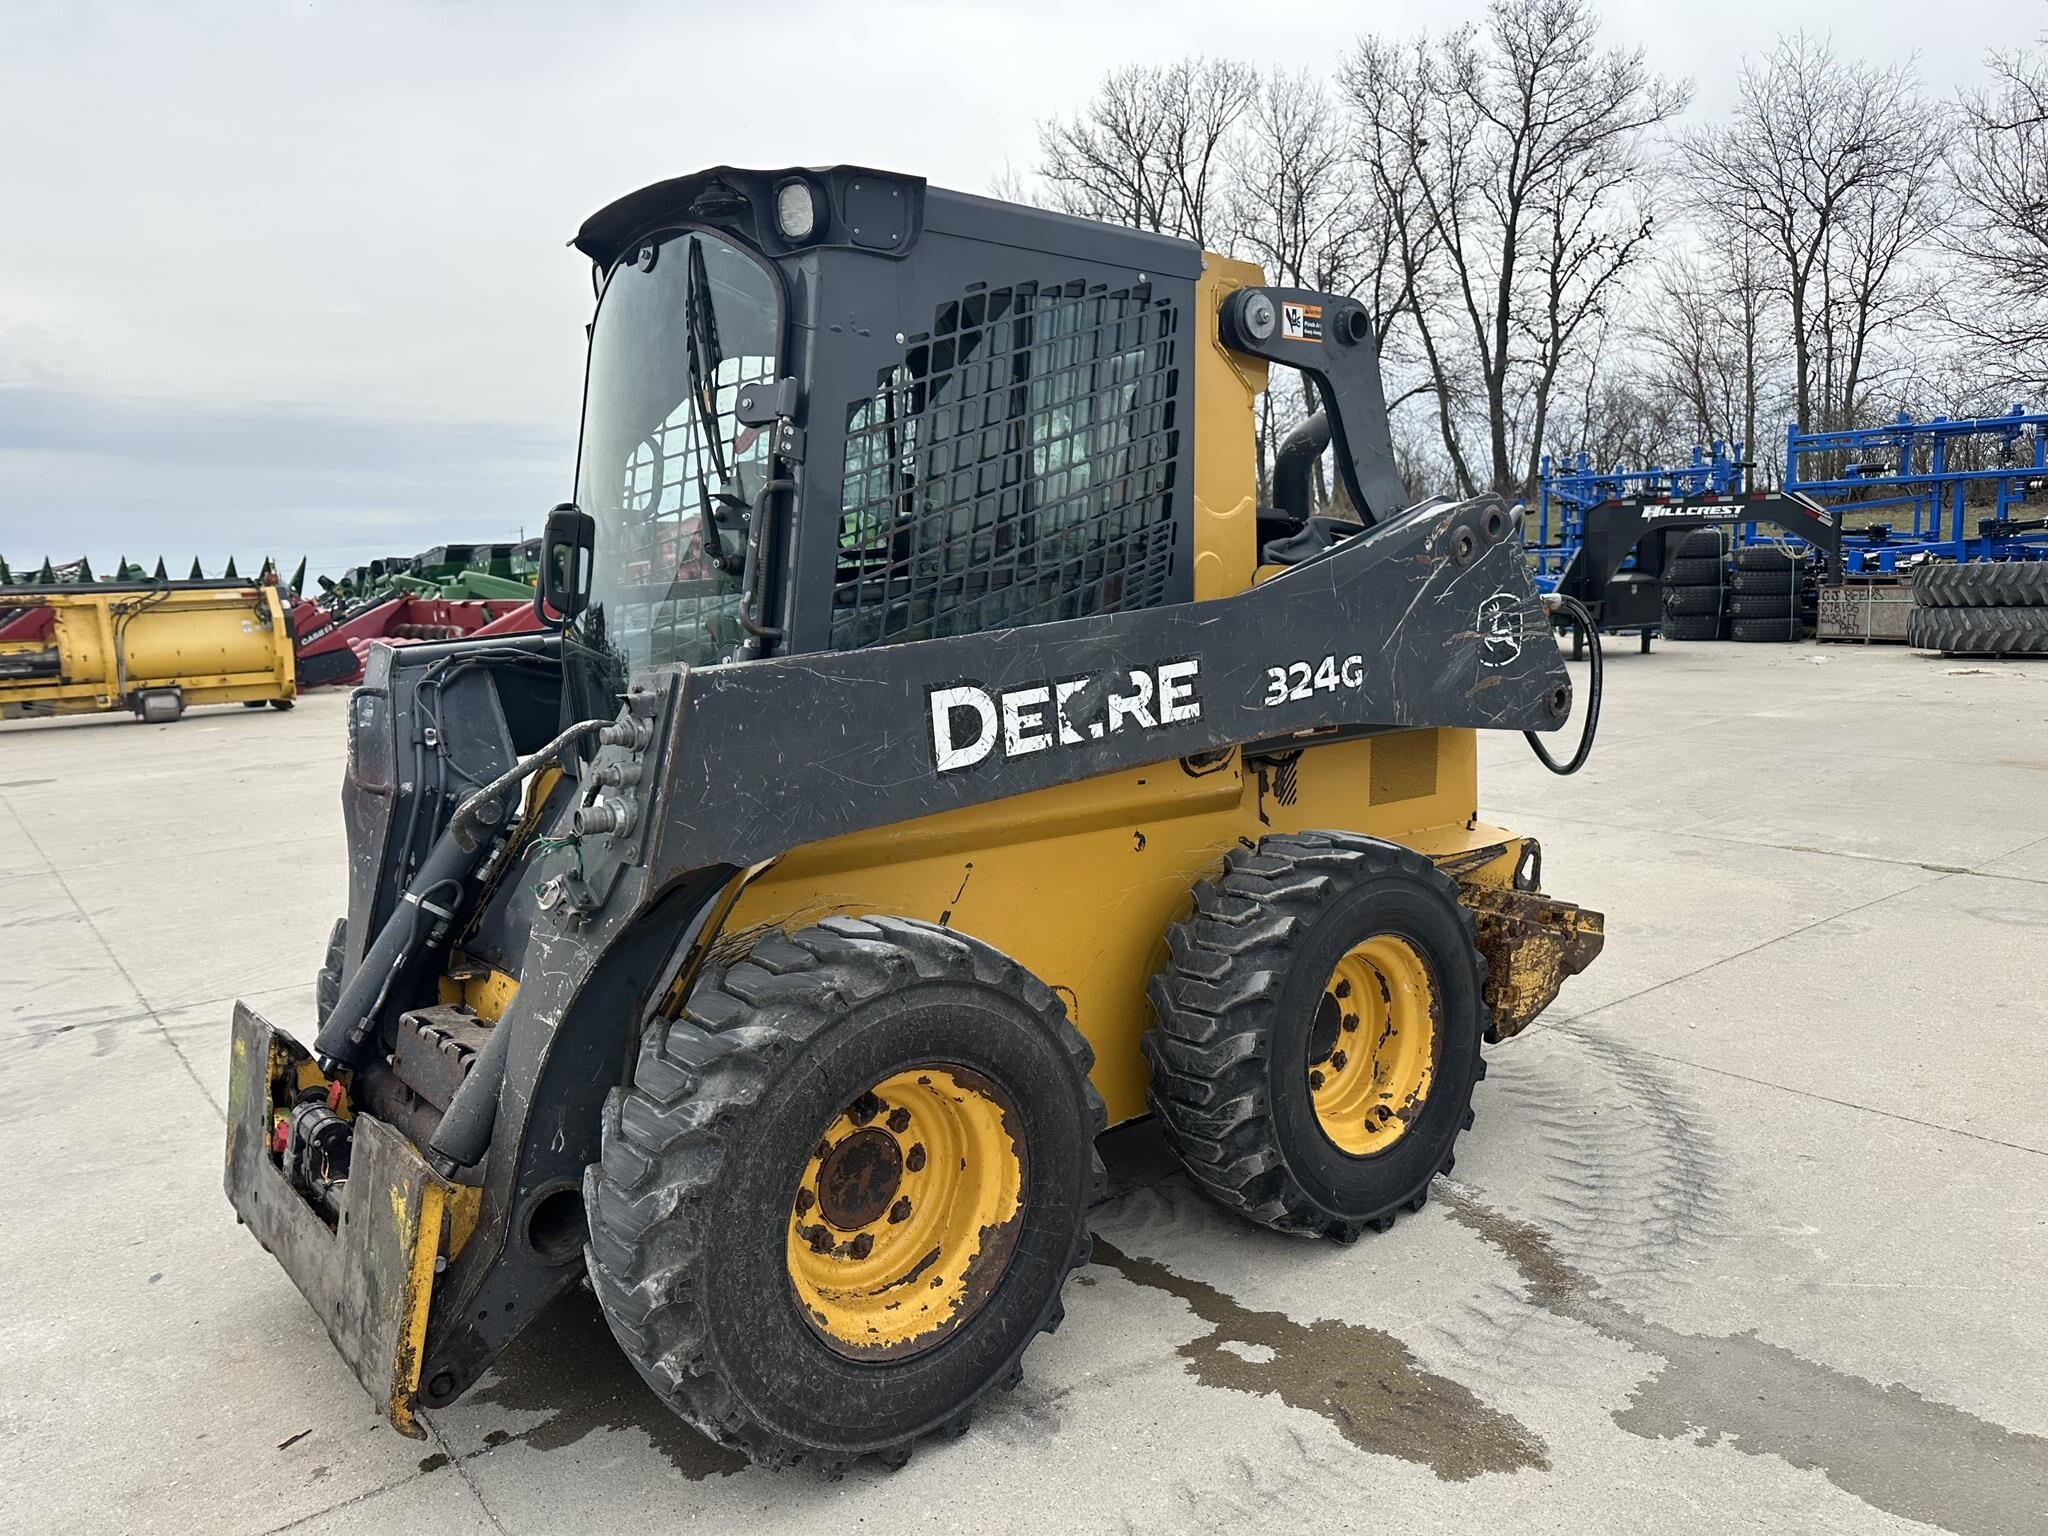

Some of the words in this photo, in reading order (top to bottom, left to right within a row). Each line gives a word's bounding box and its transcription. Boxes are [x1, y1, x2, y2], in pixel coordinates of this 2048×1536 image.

[1641, 504, 1745, 523] HILLCREST
[301, 628, 325, 646] CASE
[1264, 655, 1363, 706] 324G
